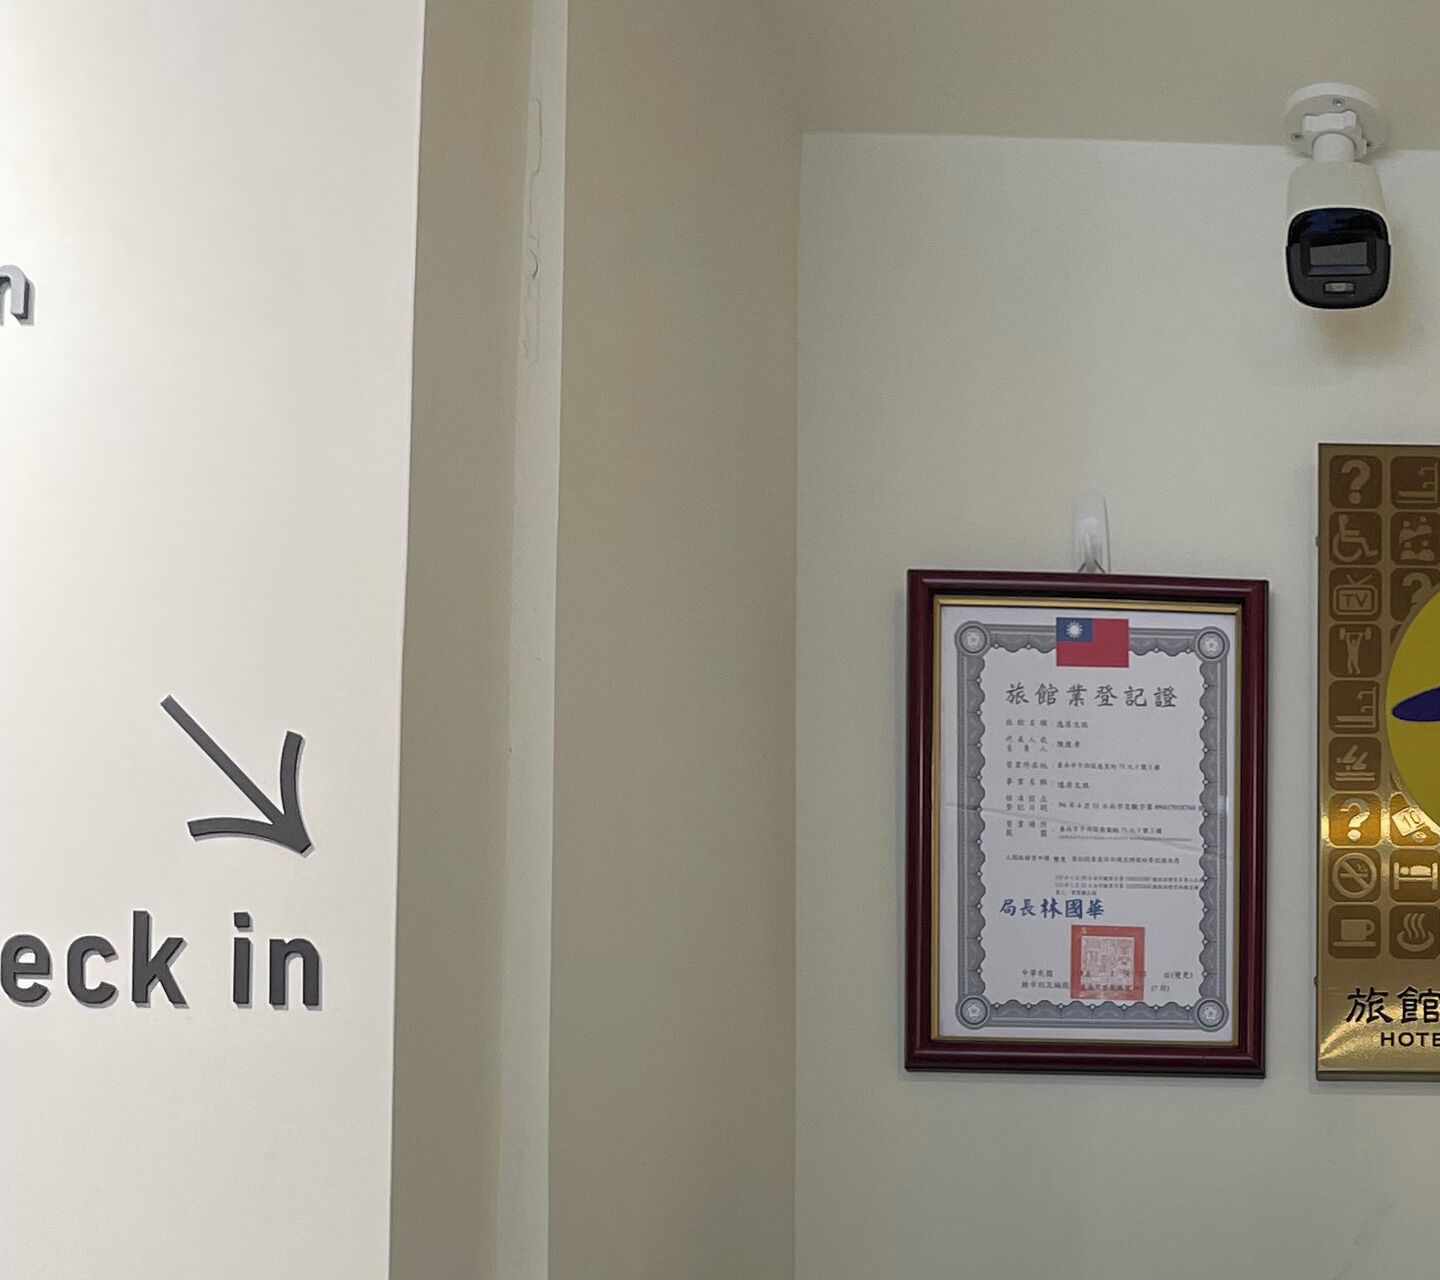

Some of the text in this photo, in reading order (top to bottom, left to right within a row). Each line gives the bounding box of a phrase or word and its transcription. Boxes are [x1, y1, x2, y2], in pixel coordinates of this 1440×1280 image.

[1006, 682, 1178, 708] 旅館業登記證
[1000, 897, 1105, 919] 局長林國華
[232, 912, 323, 1008] in
